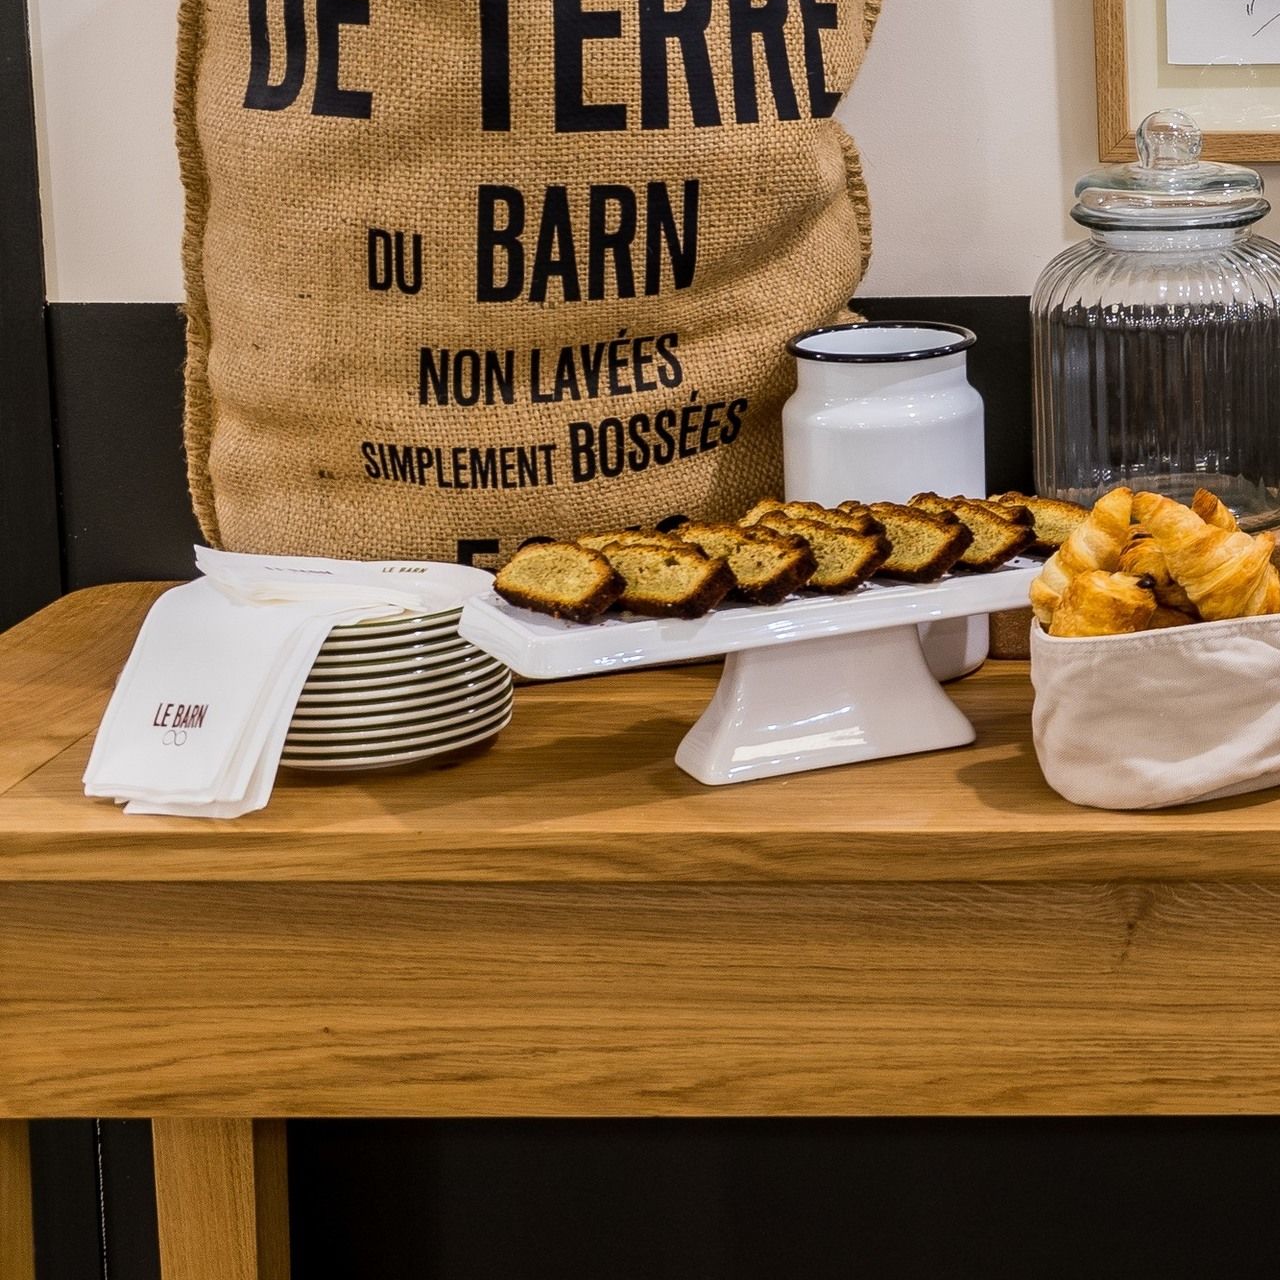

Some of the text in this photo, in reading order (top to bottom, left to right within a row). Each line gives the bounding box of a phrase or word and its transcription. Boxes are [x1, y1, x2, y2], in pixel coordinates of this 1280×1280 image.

[367, 178, 701, 305] DU BARN
[418, 329, 684, 407] NON LAVÉES
[360, 390, 749, 490] SIMPLEMENT BOSSÉES
[153, 702, 209, 729] LE BARN
